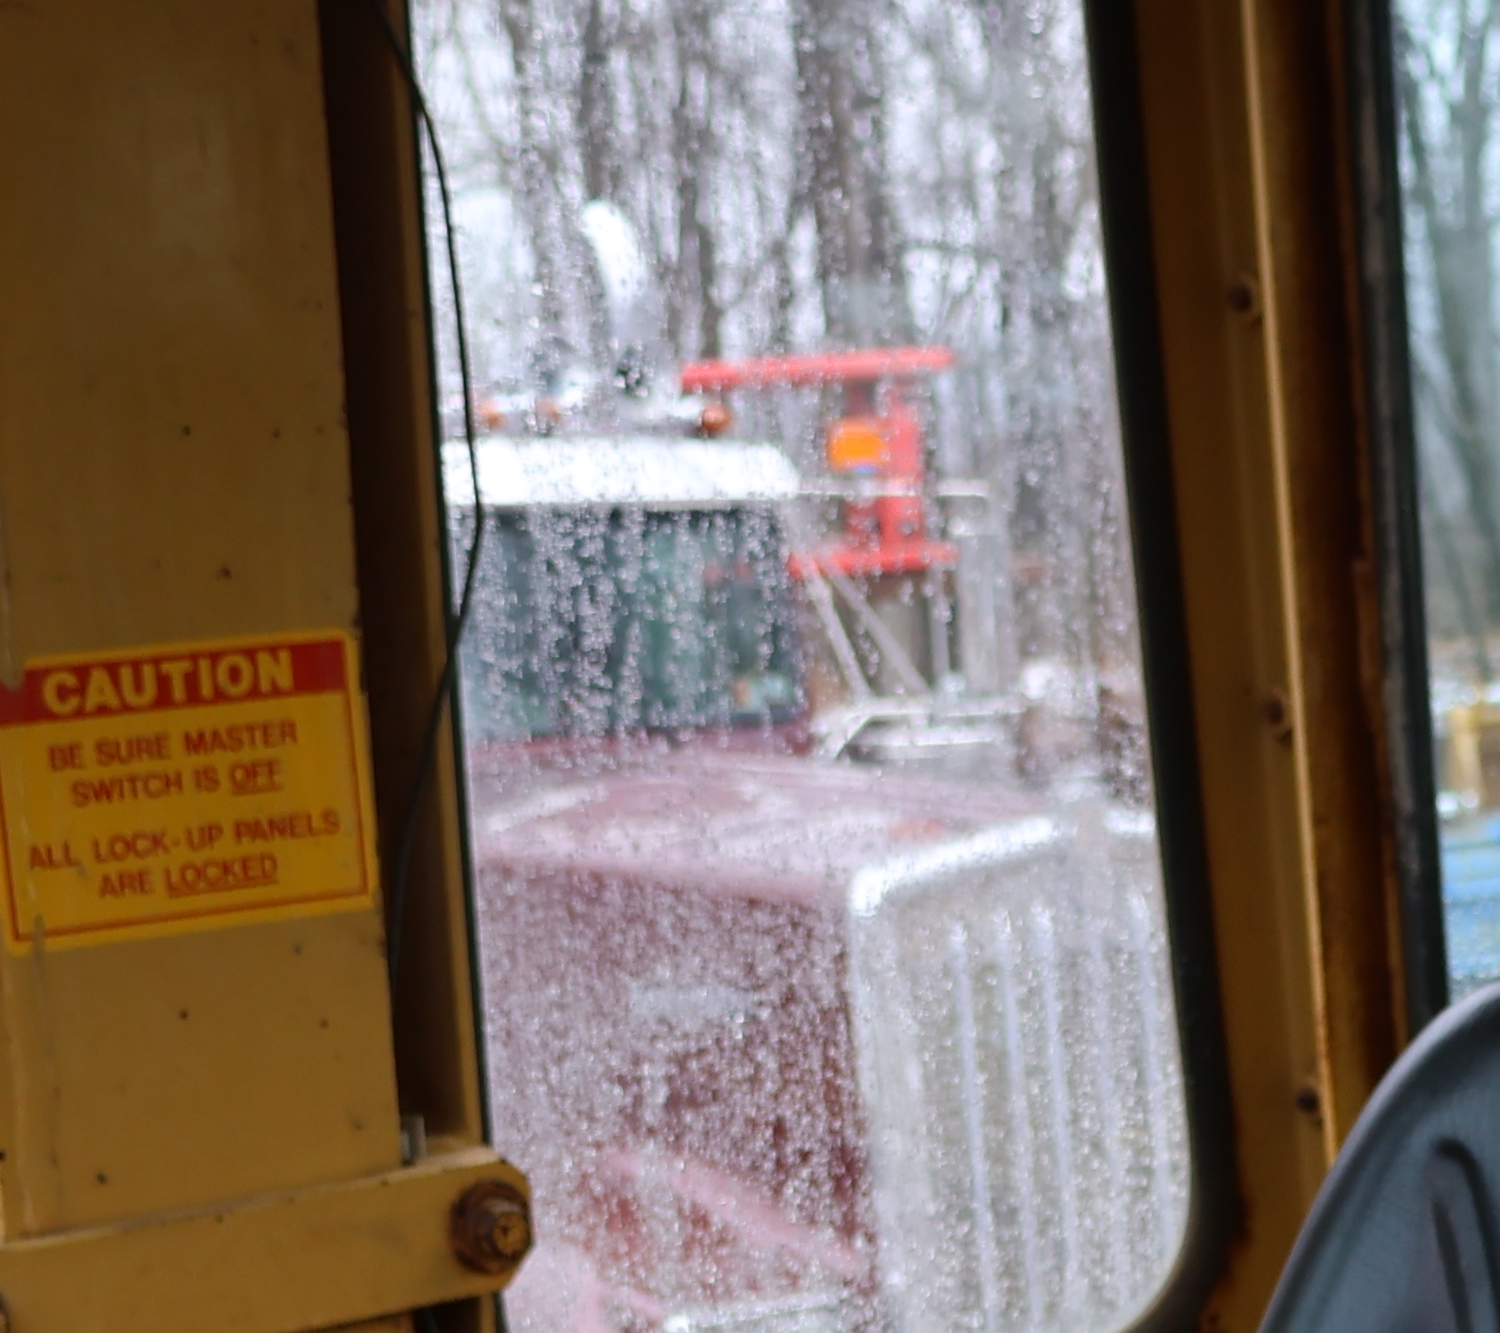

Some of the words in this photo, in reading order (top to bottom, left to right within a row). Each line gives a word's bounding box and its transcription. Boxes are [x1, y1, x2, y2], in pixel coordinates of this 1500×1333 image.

[43, 650, 294, 715] CAUTION
[49, 744, 84, 771] BE
[96, 734, 170, 765] SURE
[185, 720, 297, 755] MASTER
[72, 771, 183, 808] SWITCH
[196, 764, 221, 793] IS
[232, 760, 282, 795] OFF
[30, 840, 79, 869] ALL
[235, 809, 340, 844] PANELS
[100, 869, 154, 898] ARE
[165, 854, 279, 898] LOCKED
